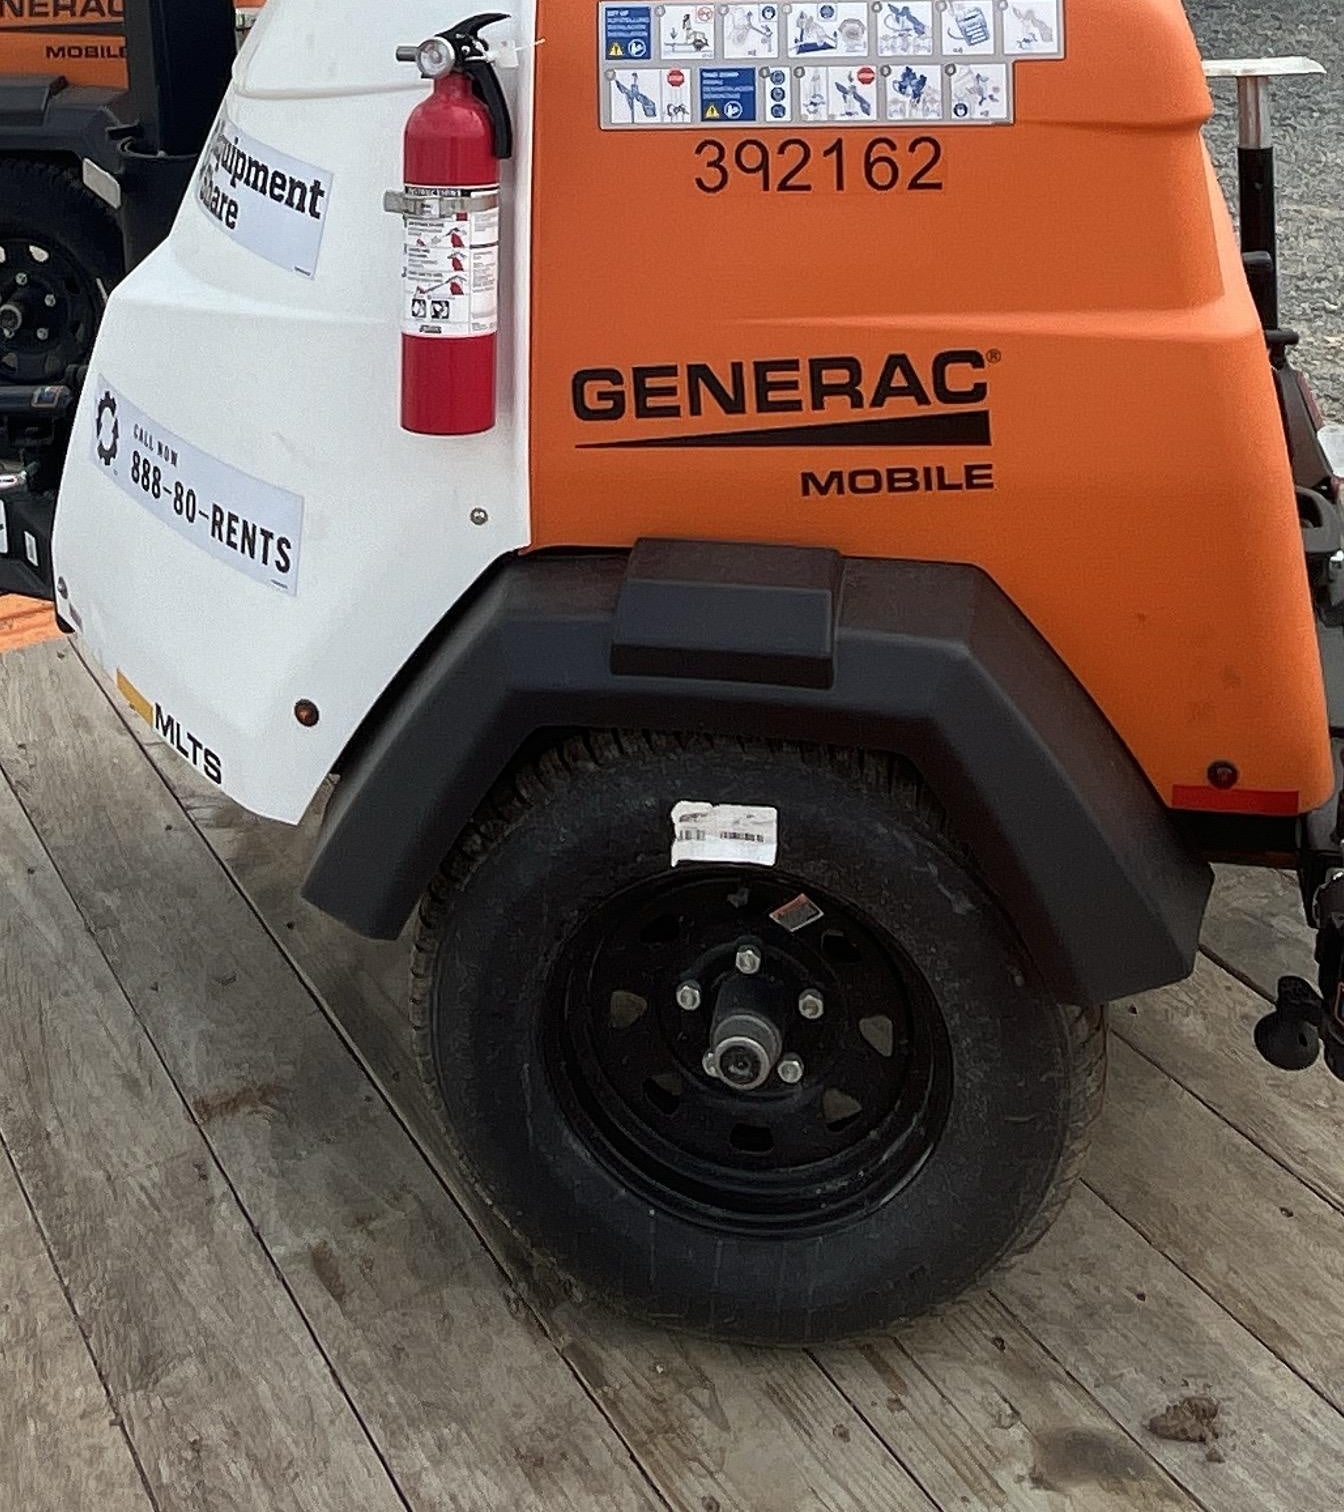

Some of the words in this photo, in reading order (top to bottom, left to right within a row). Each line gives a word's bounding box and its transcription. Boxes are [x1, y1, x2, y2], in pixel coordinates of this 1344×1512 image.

[694, 136, 943, 194] 392162
[571, 349, 989, 421] GENERAC
[133, 423, 154, 452] CALL
[157, 441, 178, 468] NOW
[131, 449, 292, 573] 888-80-RENTS
[801, 463, 995, 497] MOBILE
[155, 702, 222, 784] MLTS
